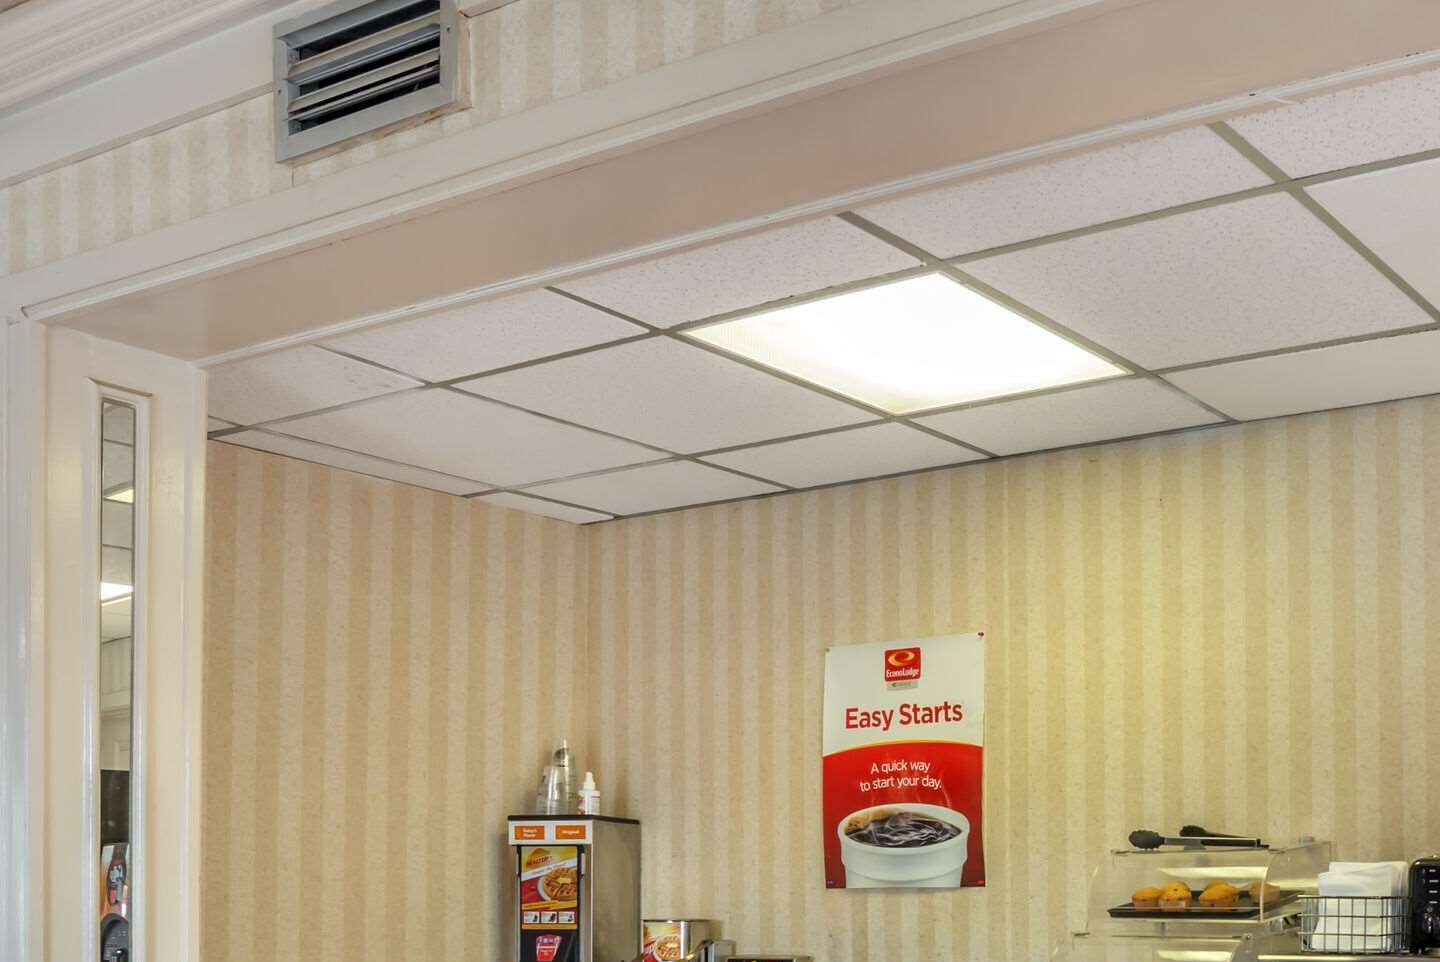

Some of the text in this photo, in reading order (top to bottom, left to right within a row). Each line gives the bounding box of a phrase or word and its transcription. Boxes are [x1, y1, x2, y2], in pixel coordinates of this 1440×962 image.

[845, 700, 963, 731] Easy Starts
[870, 759, 931, 775] A quick way
[860, 774, 942, 792] to start your day.
